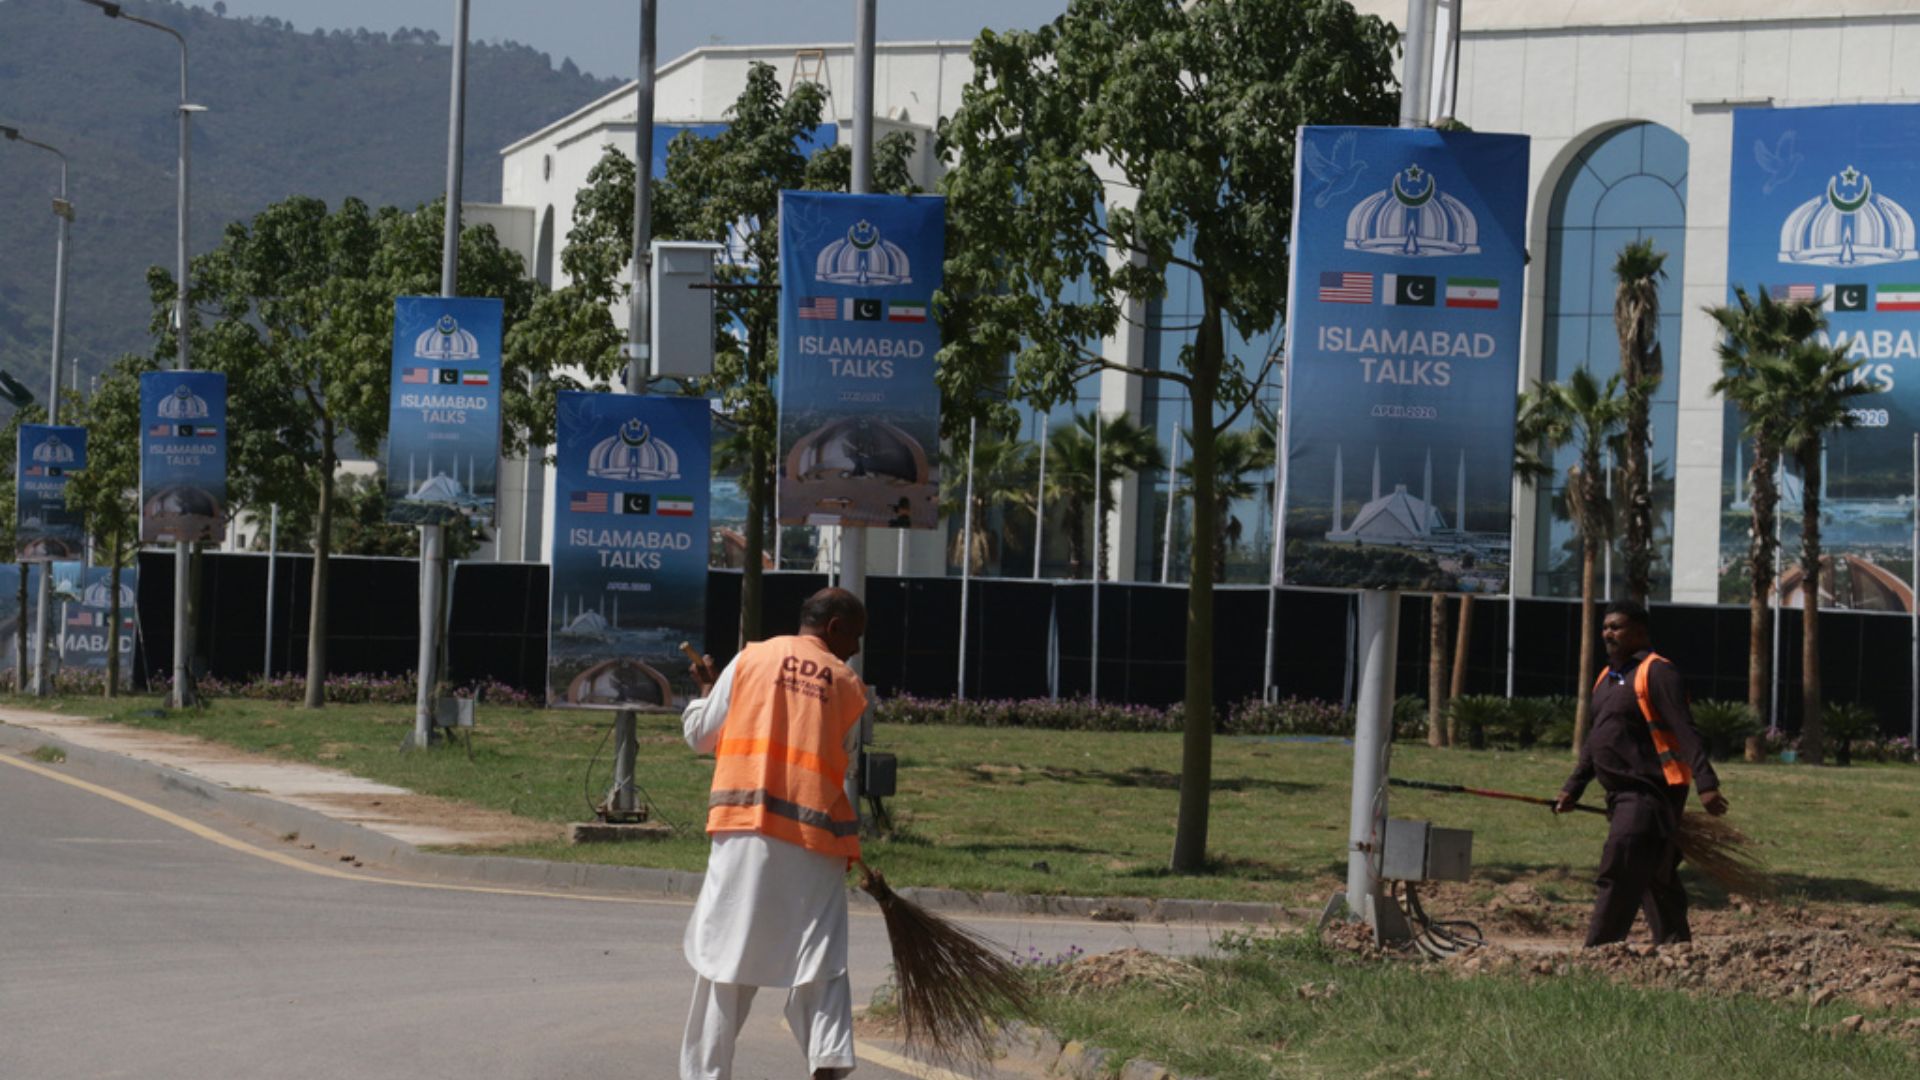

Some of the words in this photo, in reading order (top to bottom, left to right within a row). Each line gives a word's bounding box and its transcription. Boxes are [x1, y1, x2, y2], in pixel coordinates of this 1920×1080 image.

[799, 335, 925, 358] ISLAMABAD
[1318, 326, 1496, 358] ISLAMABAD
[829, 358, 894, 379] TALKS
[1359, 357, 1451, 386] TALKS
[401, 393, 489, 410] ISLAMABAD
[422, 408, 467, 424] TALKS
[150, 443, 217, 455] ISLAMABAD
[166, 455, 201, 466] TALKS
[569, 528, 692, 550] ISLAMABAD
[598, 550, 662, 569] TALKS
[782, 655, 834, 686] CDA
